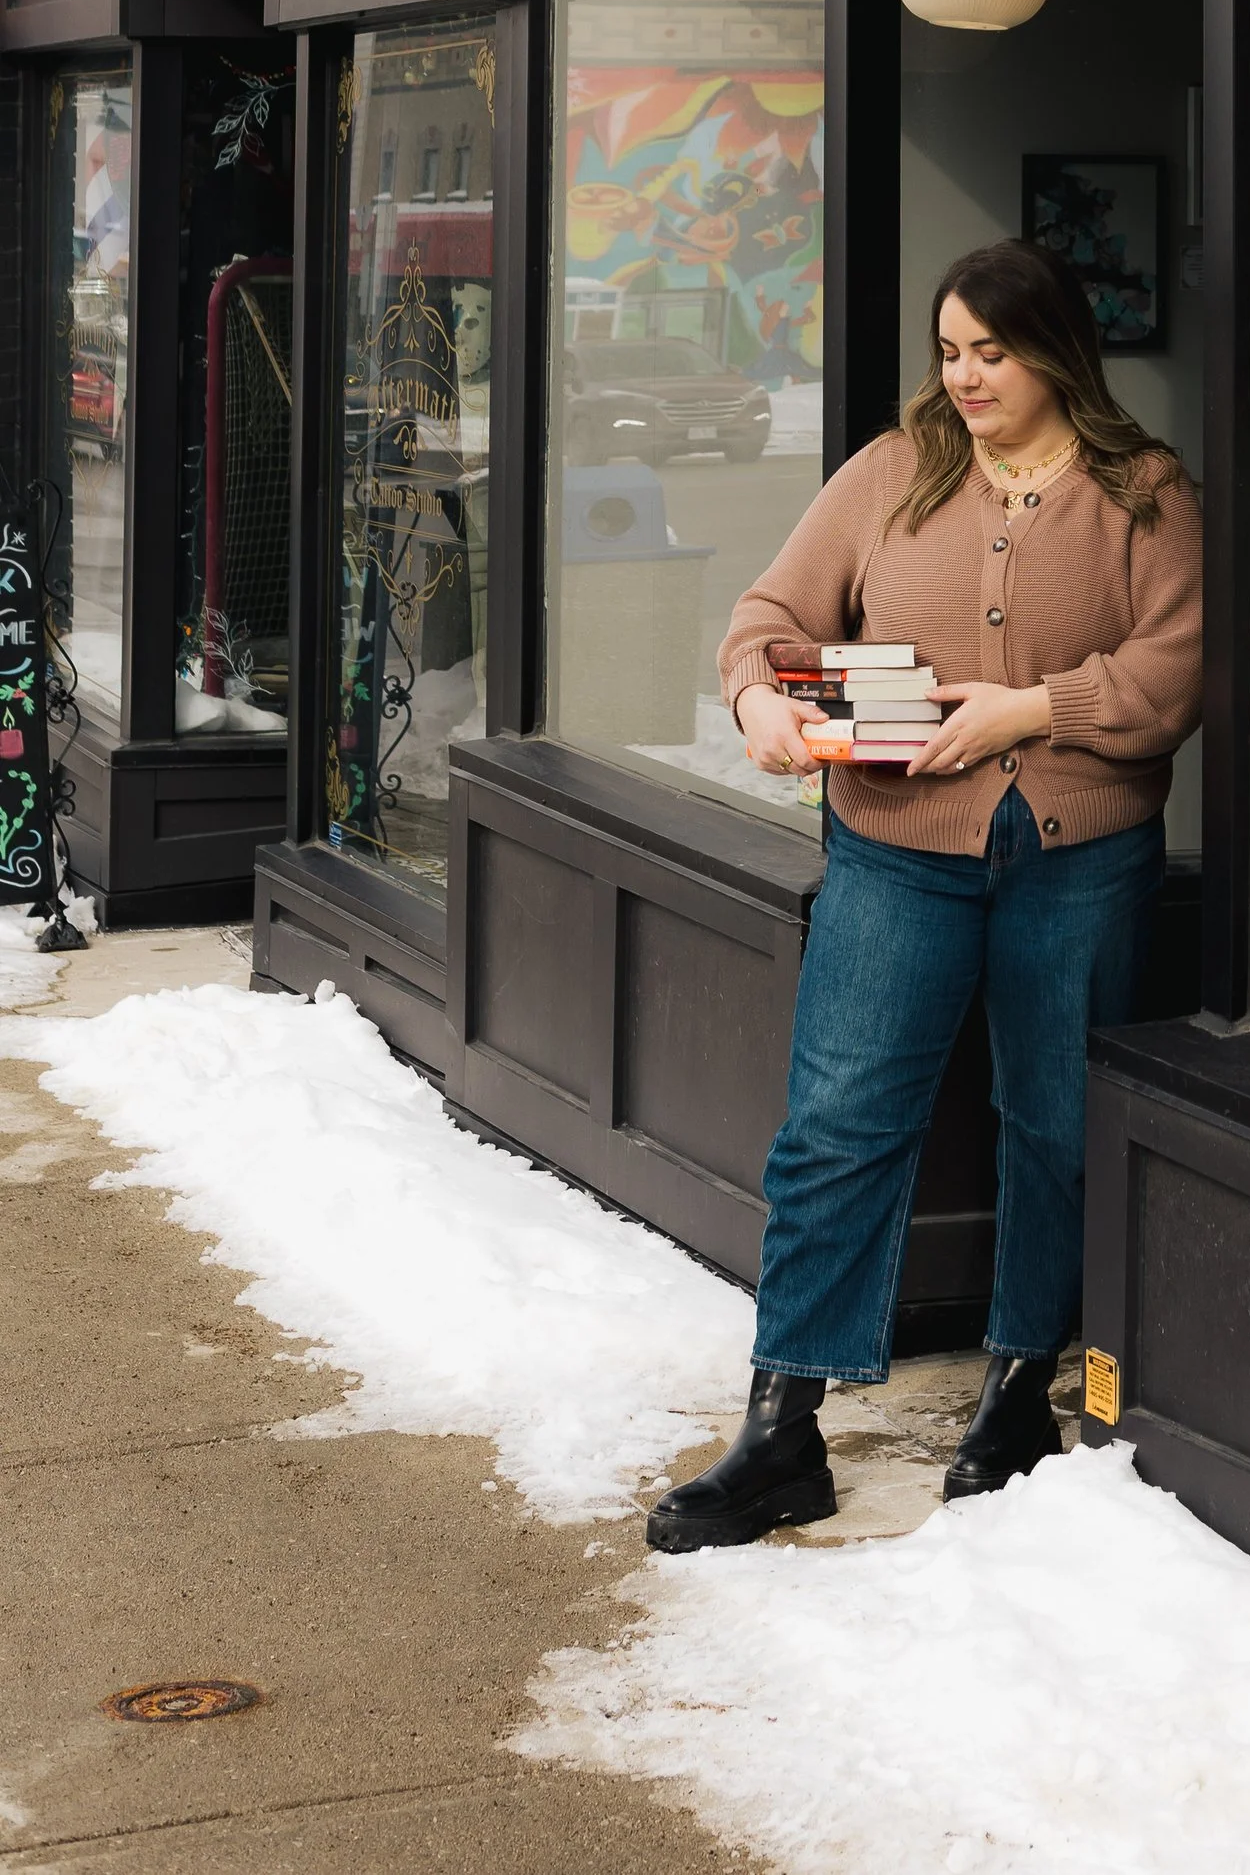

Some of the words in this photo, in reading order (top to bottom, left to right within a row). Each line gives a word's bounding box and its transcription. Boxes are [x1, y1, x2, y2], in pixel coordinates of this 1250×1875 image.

[367, 376, 457, 444] Aftermath
[370, 477, 403, 510] Tattoo
[405, 483, 443, 517] Studio
[822, 745, 838, 756] KING
